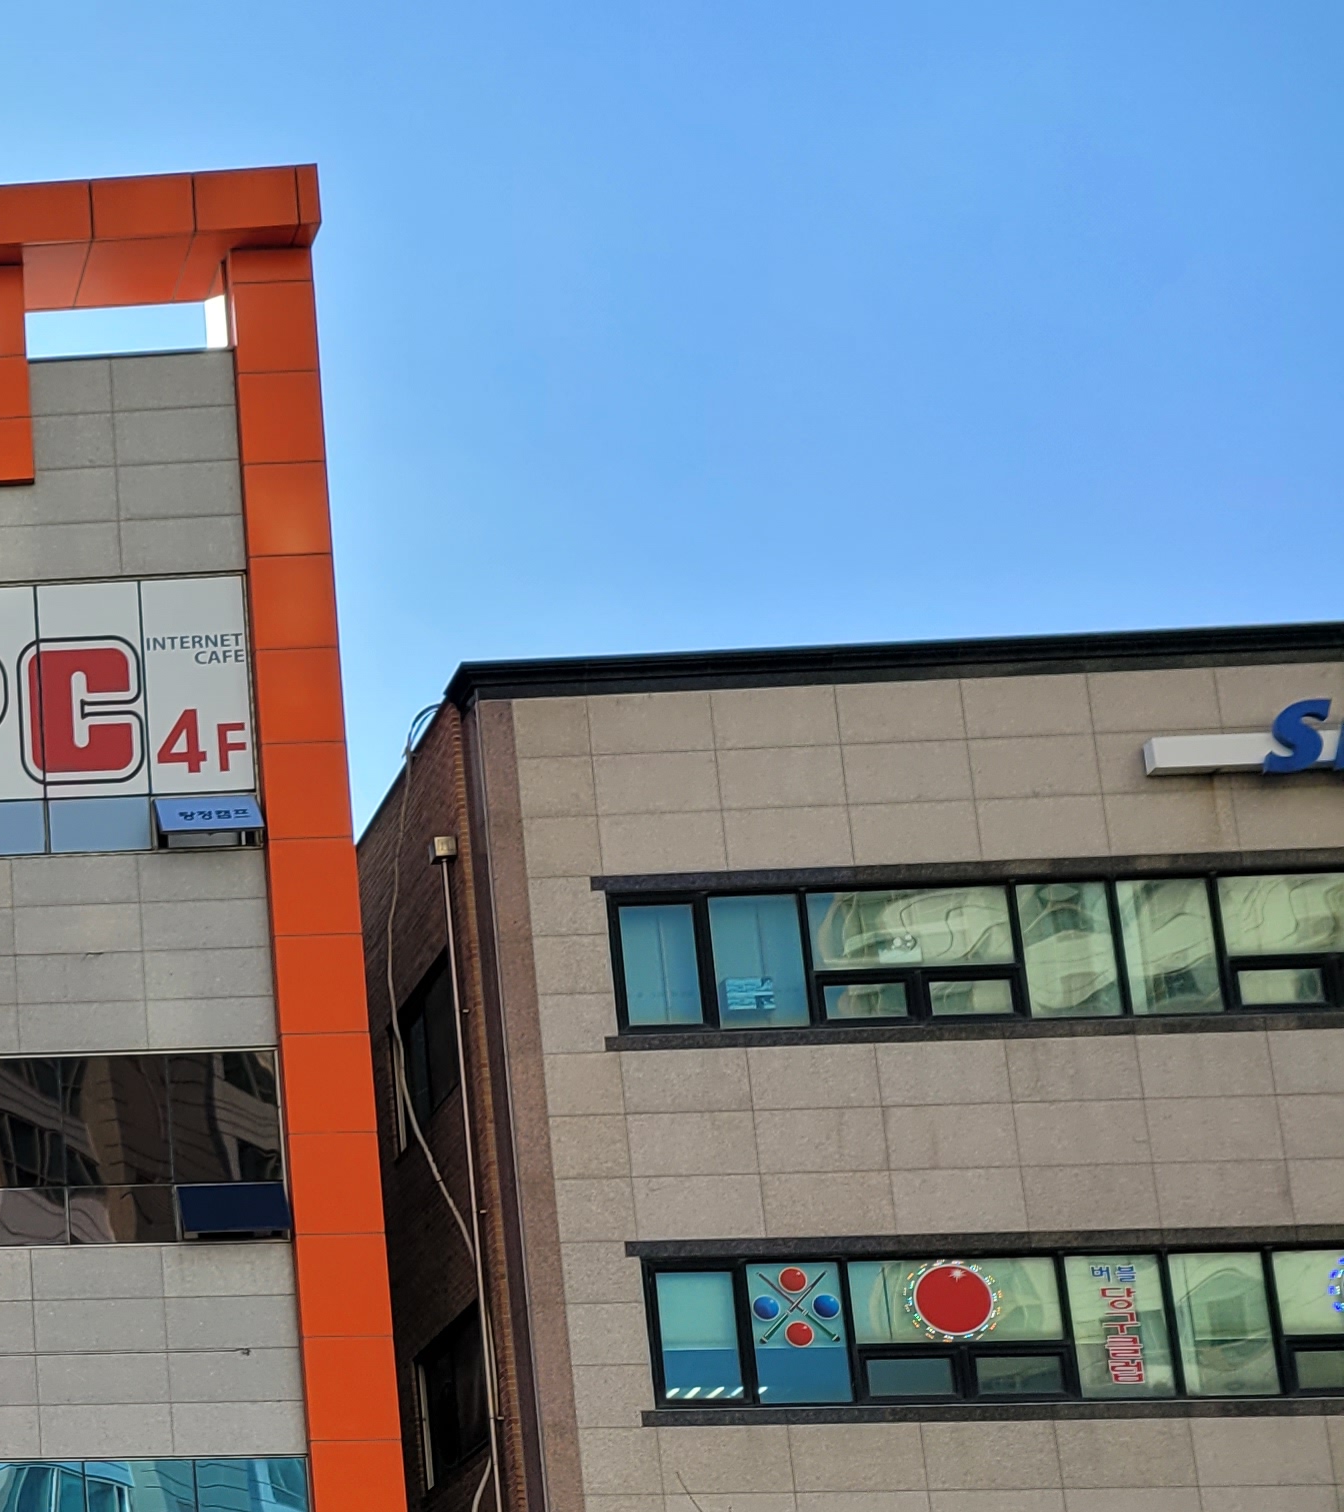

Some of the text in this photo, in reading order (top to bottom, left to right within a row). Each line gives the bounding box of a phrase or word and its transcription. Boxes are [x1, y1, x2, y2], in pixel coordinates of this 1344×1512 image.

[145, 632, 244, 651] INTERNET
[193, 649, 246, 666] CAFE
[156, 708, 248, 774] 4F
[178, 807, 252, 821] 탕정캠프
[1090, 1265, 1136, 1283] 버블
[1100, 1286, 1145, 1384] 당구클럽
